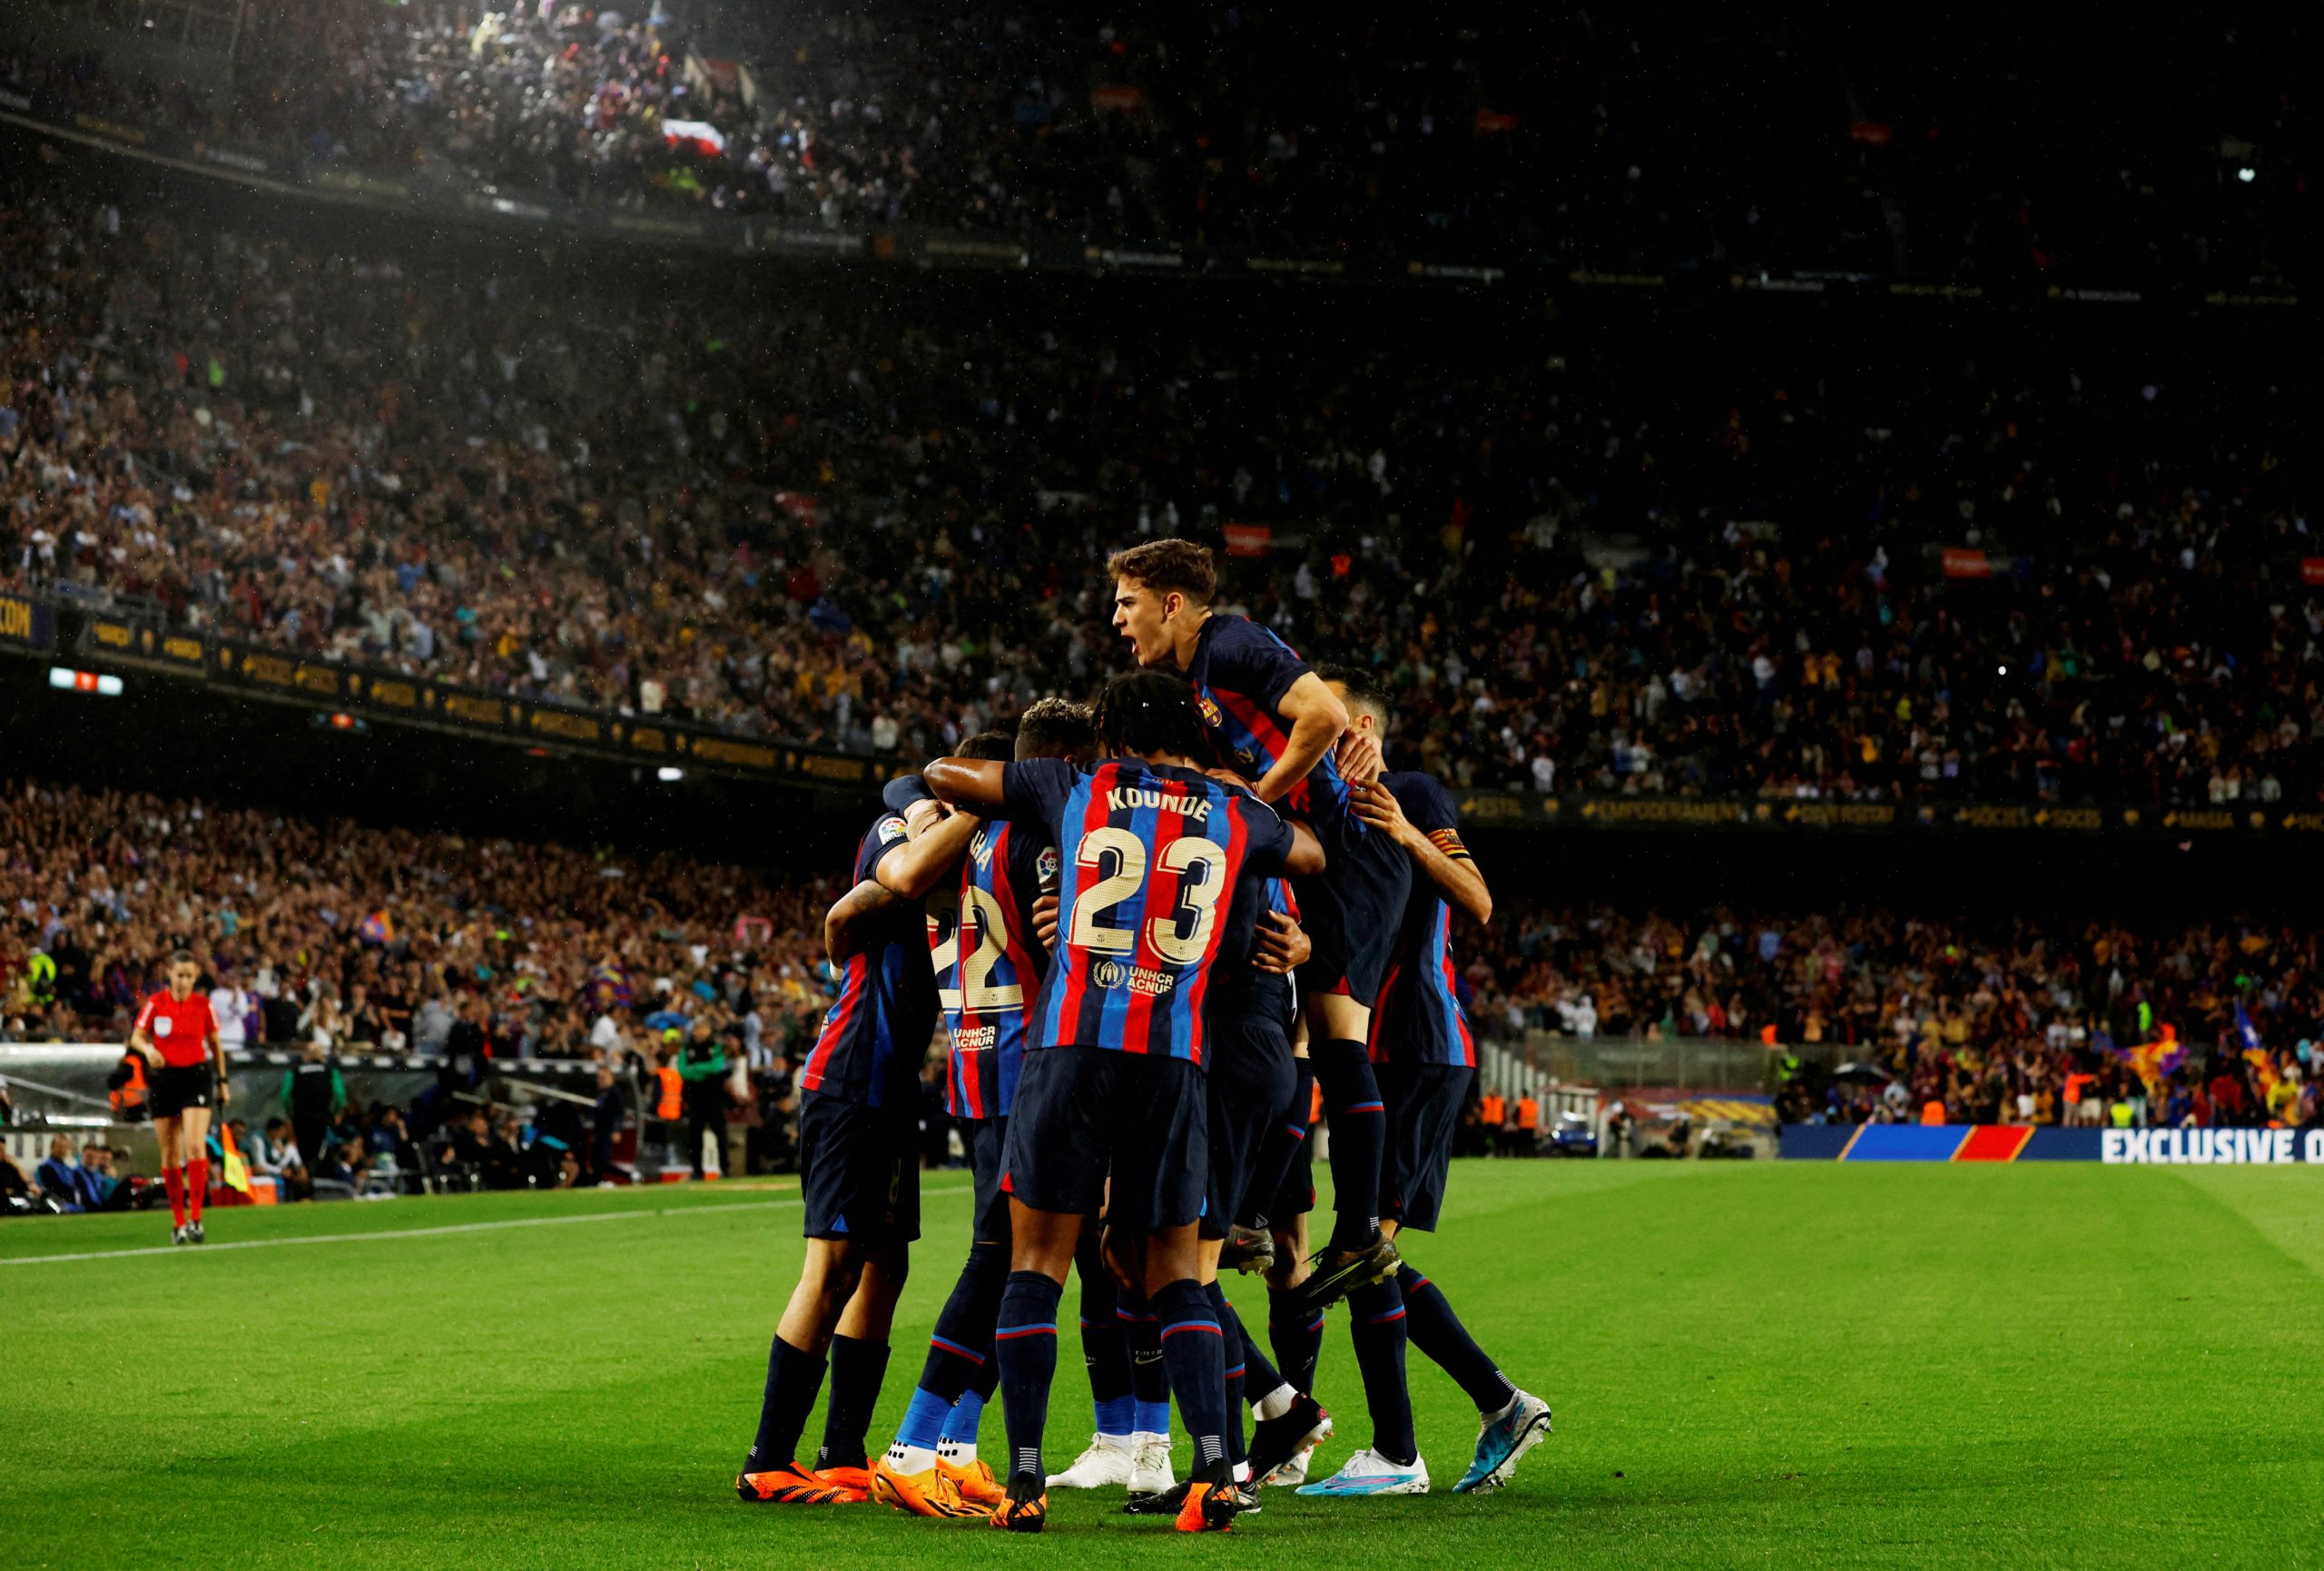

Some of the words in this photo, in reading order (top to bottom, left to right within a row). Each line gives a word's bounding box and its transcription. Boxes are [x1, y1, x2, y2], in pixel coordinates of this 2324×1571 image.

[1106, 786, 1214, 823] KOUNDE
[1066, 826, 1227, 965] 23
[926, 885, 1024, 1014] 22
[1128, 965, 1174, 986] UNHCR
[953, 1025, 996, 1038] UNHCR
[2101, 1128, 2296, 1164] EXCLUSIVE
